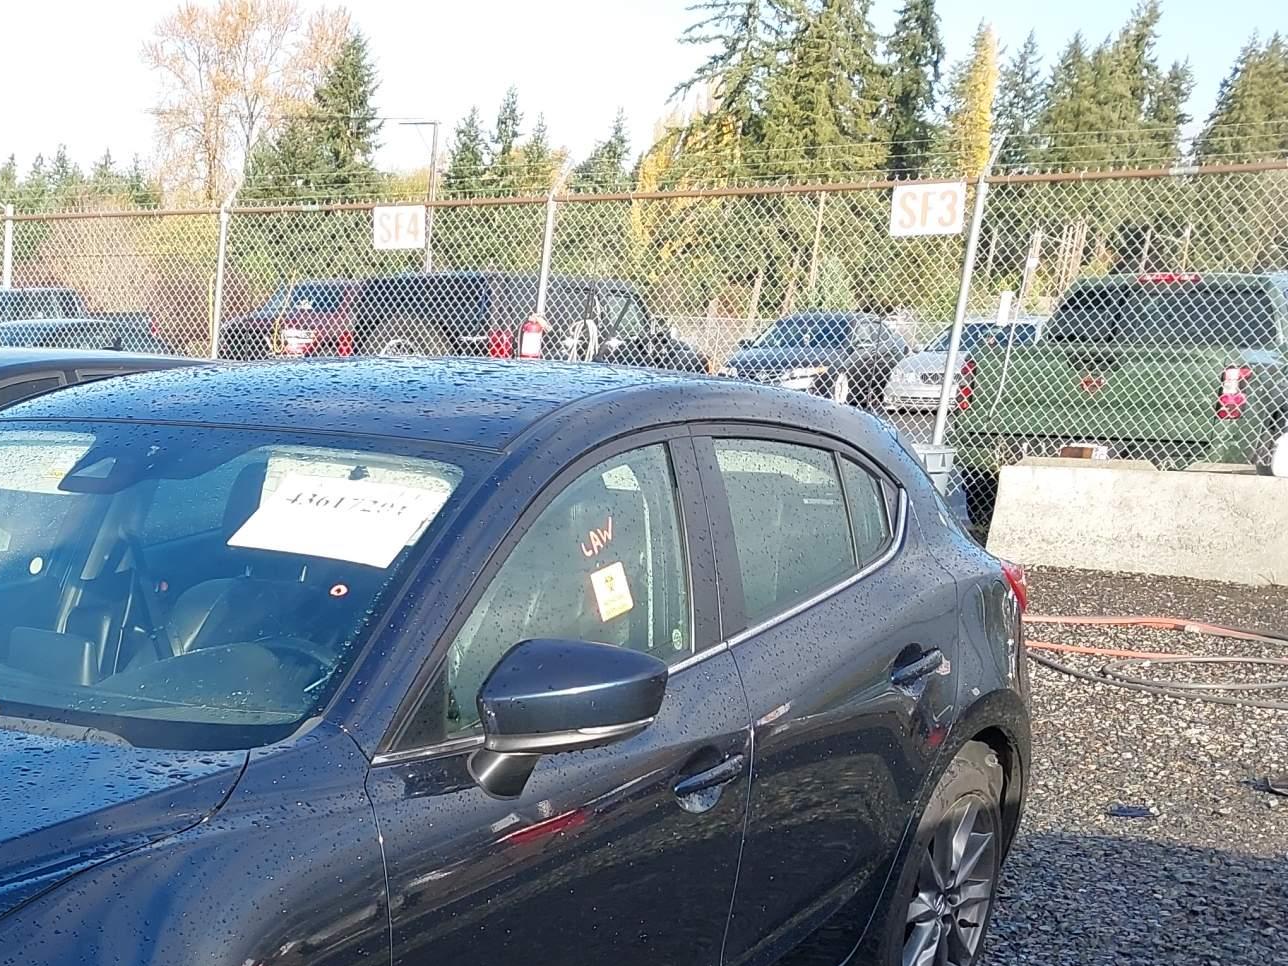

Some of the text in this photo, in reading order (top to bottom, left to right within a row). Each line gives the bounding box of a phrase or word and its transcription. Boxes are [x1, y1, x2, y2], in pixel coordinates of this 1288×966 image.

[379, 212, 420, 243] SF4
[898, 190, 958, 229] SF3
[580, 516, 612, 557] LAW
